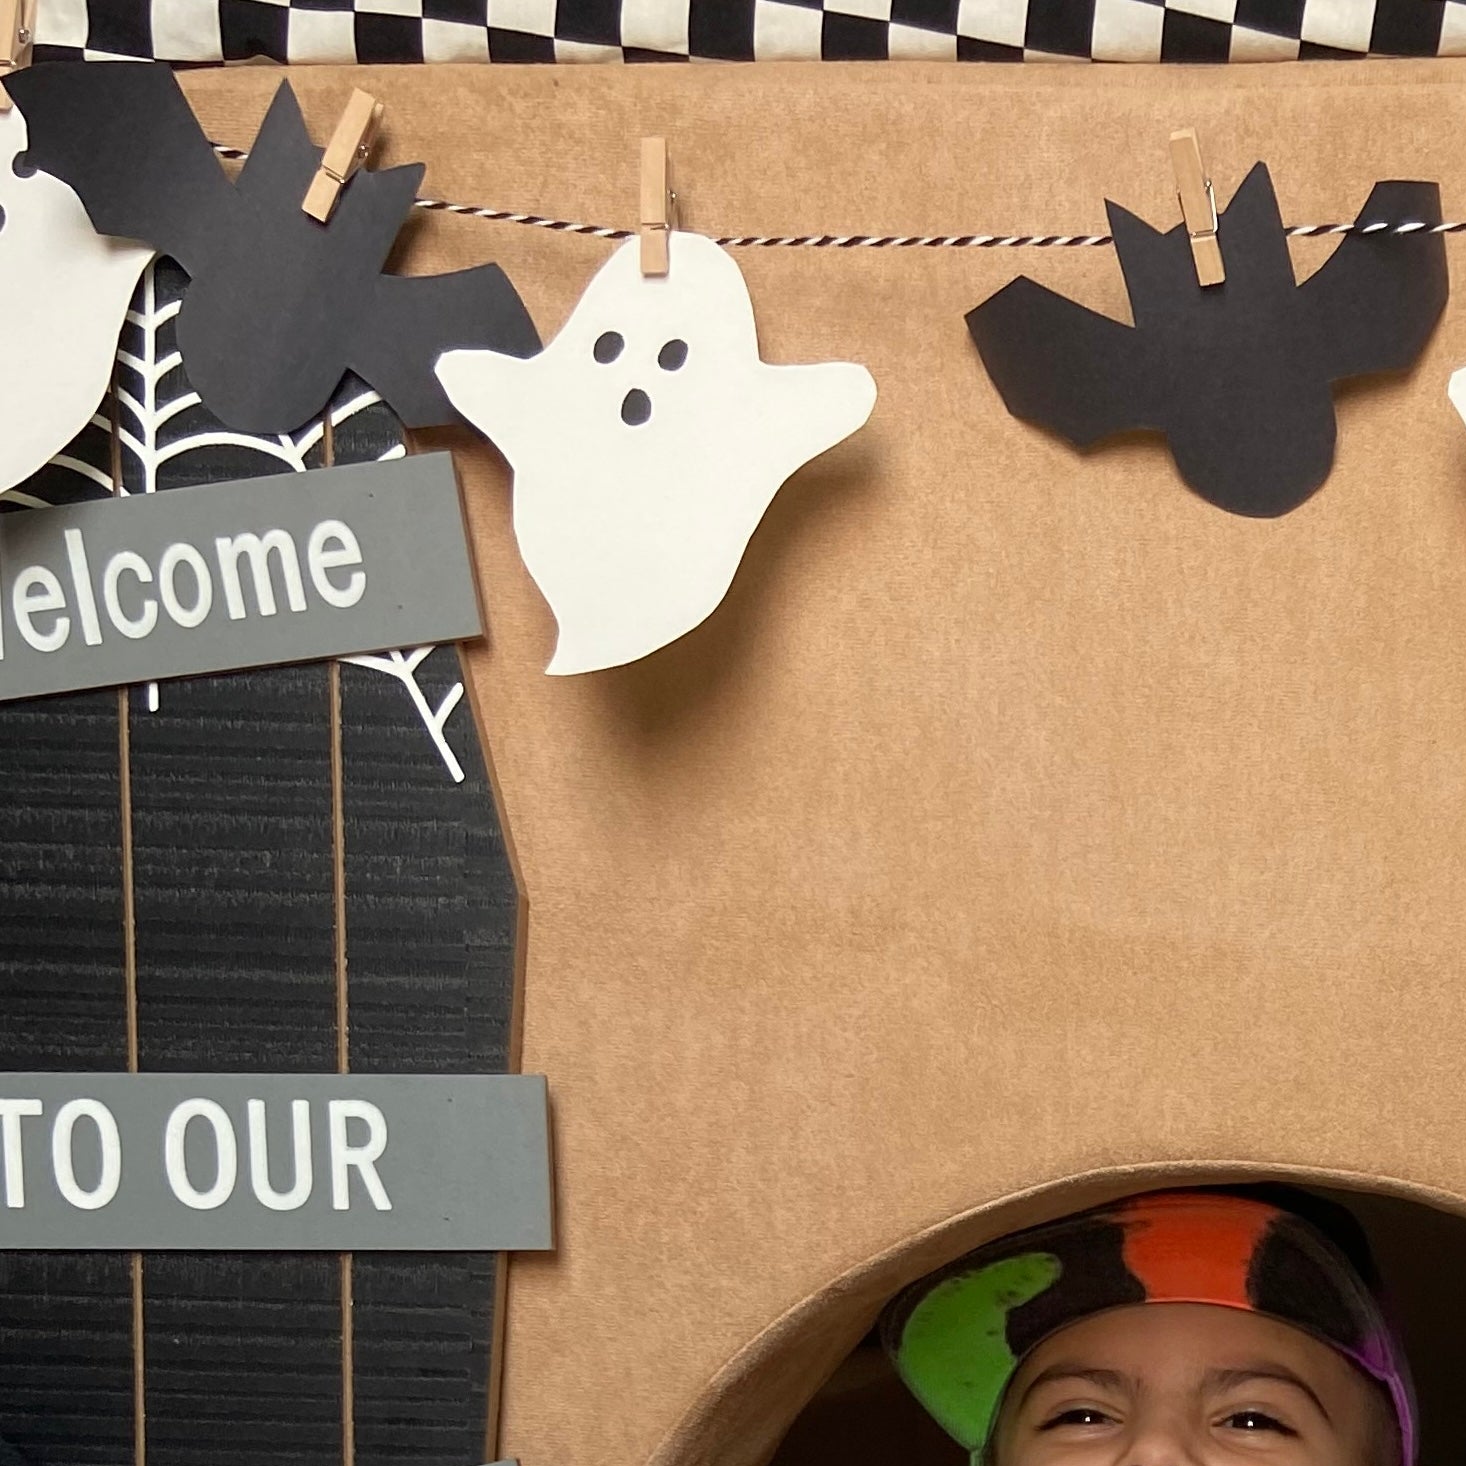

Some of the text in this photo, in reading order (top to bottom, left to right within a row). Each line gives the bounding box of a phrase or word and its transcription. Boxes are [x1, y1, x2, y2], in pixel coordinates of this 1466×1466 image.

[0, 519, 368, 660] elcome
[0, 1098, 392, 1211] TO OUR
